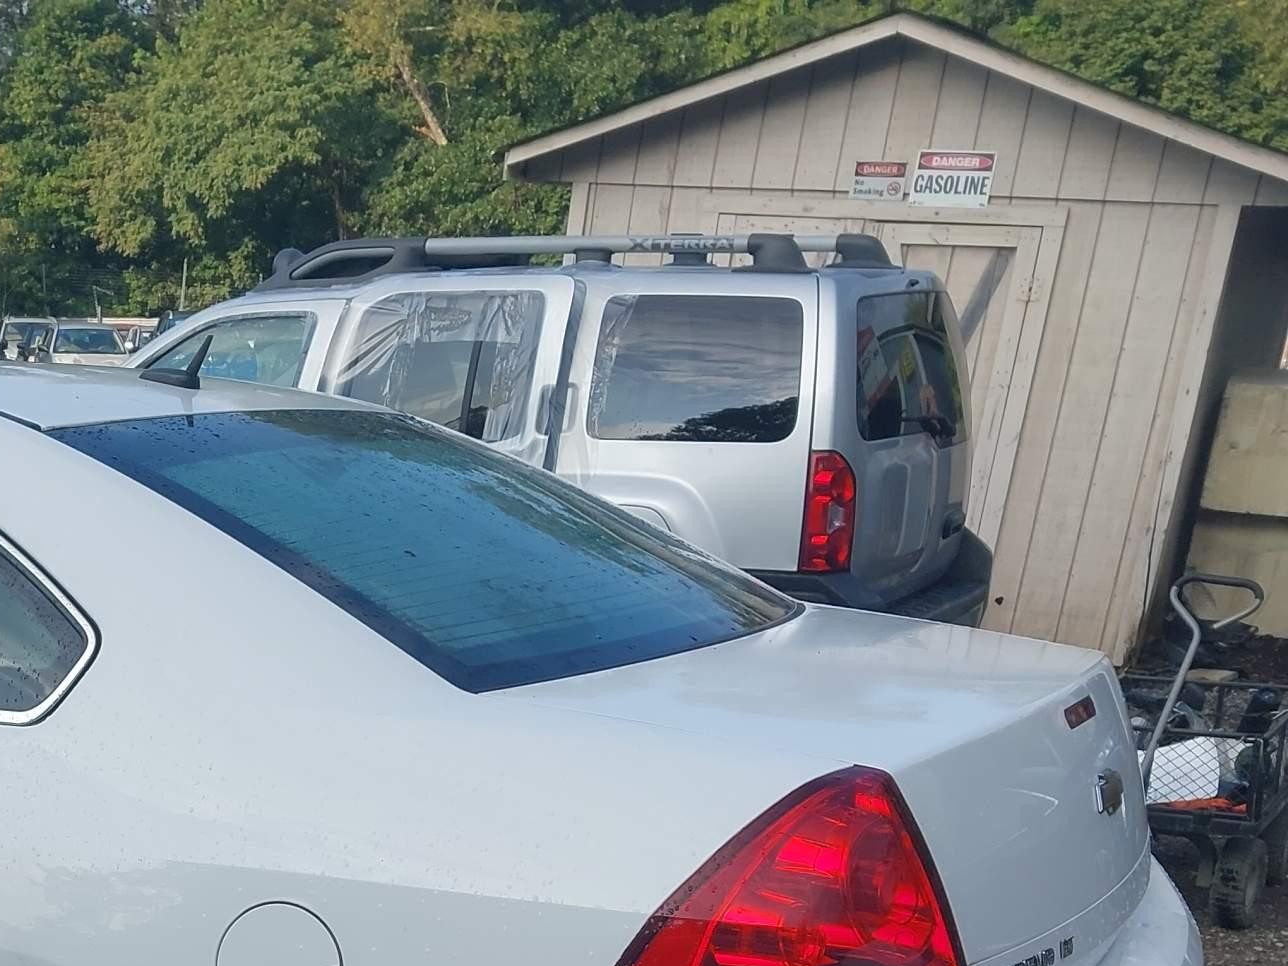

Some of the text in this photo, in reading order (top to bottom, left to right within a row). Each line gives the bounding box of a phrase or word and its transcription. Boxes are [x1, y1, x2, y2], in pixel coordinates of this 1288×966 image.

[932, 157, 980, 168] DANGER
[863, 164, 898, 174] DANGER
[914, 174, 990, 195] GASOLINE
